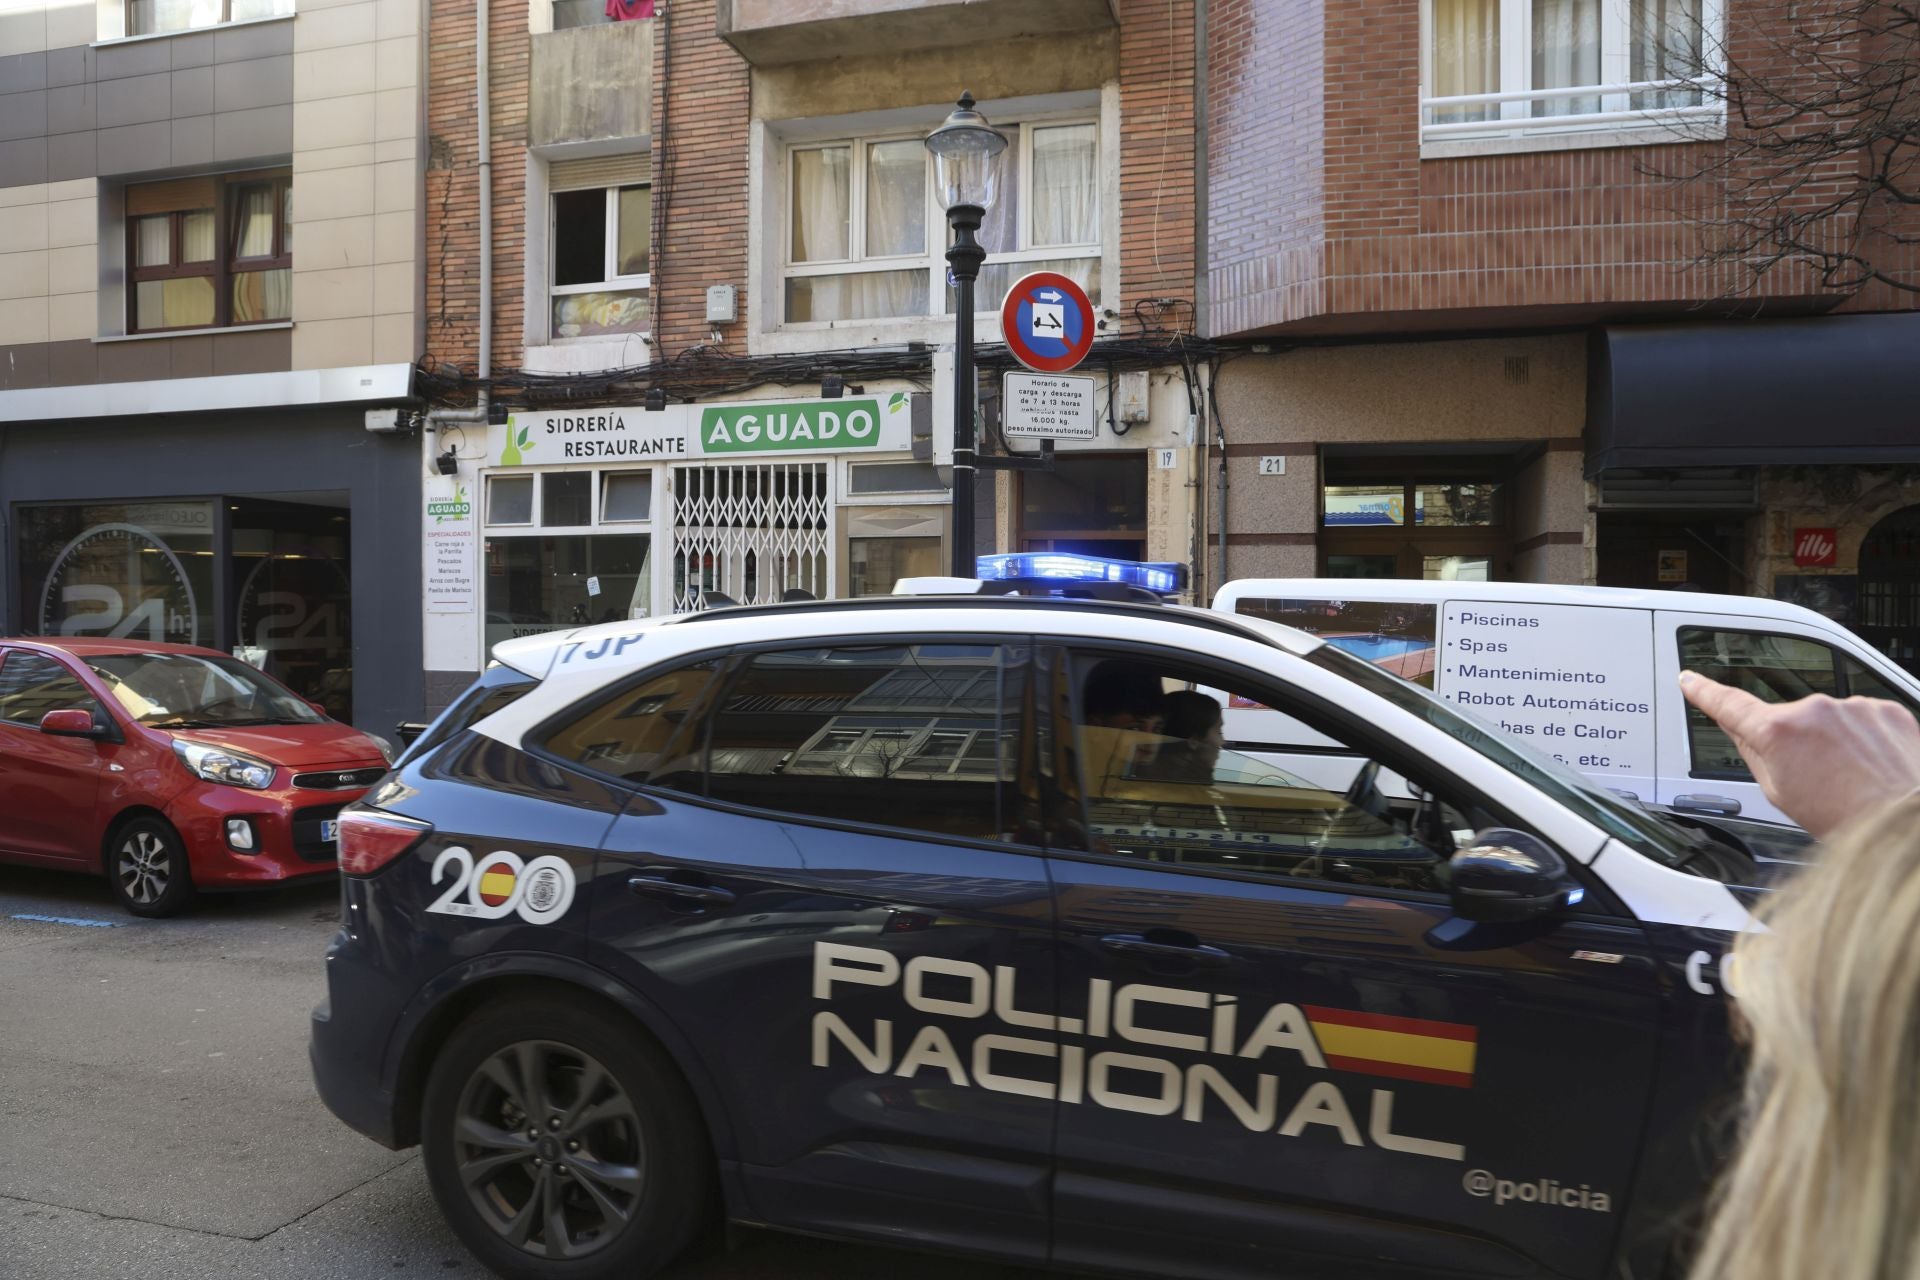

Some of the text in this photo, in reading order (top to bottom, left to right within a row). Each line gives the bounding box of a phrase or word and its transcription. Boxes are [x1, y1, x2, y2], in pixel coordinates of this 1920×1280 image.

[1031, 379, 1070, 388] Horario de
[1049, 398, 1057, 406] 13
[1061, 399, 1081, 407] horas
[1050, 390, 1082, 399] descarga
[545, 411, 626, 434] SIDRERÍA
[707, 408, 873, 445] AGUADO
[1059, 417, 1070, 426] kg.
[1055, 427, 1093, 435] autorizado
[564, 437, 686, 457] RESTAURANTE
[1162, 452, 1173, 466] 19
[1266, 458, 1280, 473] 21
[428, 503, 469, 514] AGUADO
[1796, 533, 1834, 562] illy
[1460, 612, 1540, 628] Piscinas
[1459, 638, 1508, 654] Spas
[1458, 664, 1606, 684] Mantenimiento
[1457, 691, 1650, 714] Robot Automáticos
[1543, 722, 1566, 737] de
[1574, 724, 1628, 740] Calor
[425, 846, 576, 925] 200
[814, 941, 1329, 1069] POLICÍA
[812, 1011, 1465, 1161] NACIONAL
[1462, 1168, 1611, 1213] @policia
